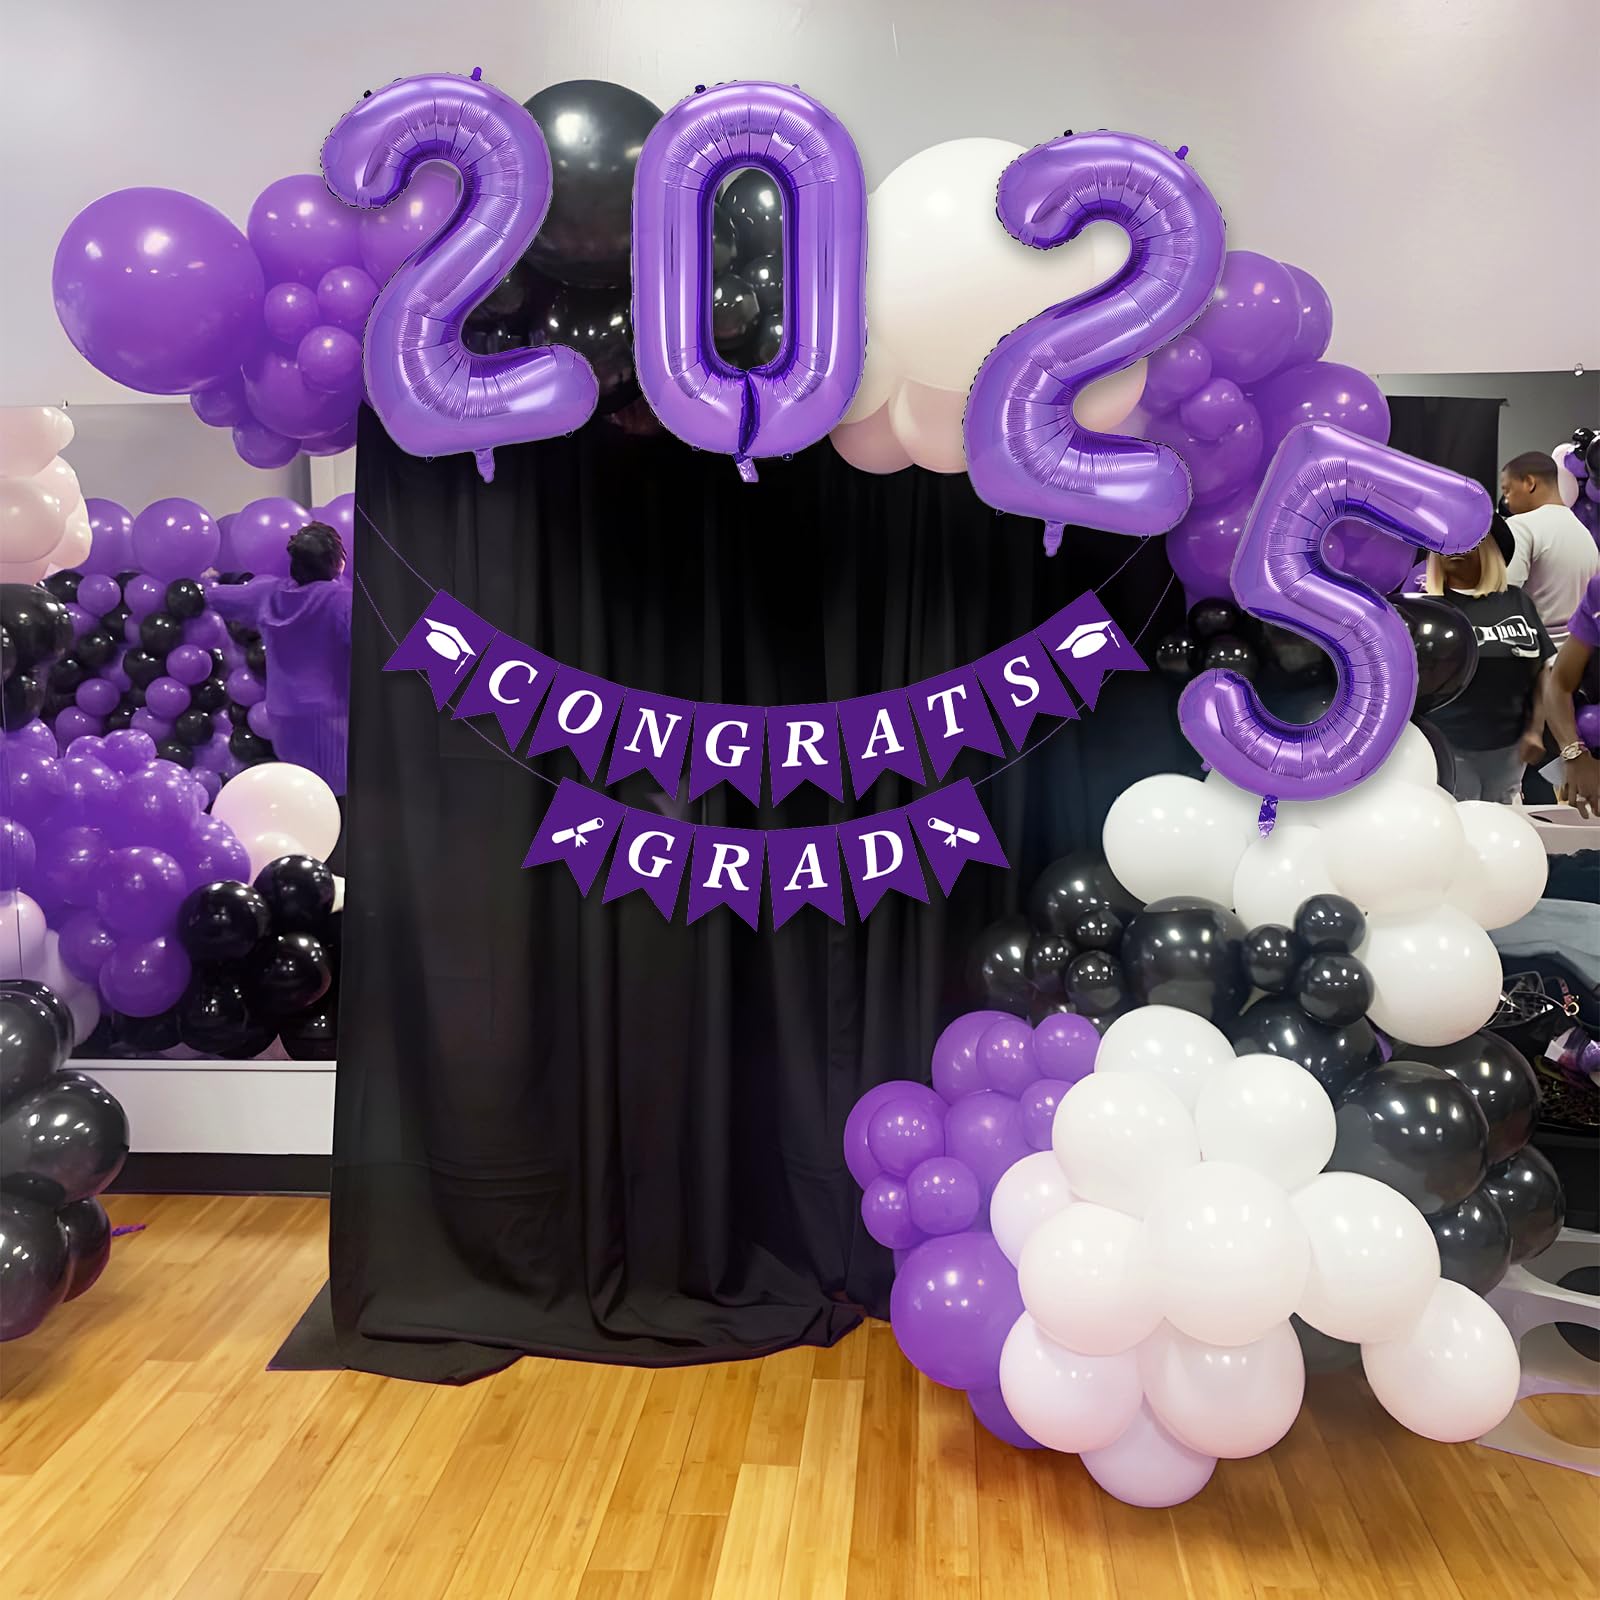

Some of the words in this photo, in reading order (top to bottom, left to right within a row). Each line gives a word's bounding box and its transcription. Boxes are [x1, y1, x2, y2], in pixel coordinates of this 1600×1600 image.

[320, 70, 1492, 803] 2025
[488, 655, 1040, 768] CONGRATS
[627, 830, 904, 892] GRAD
